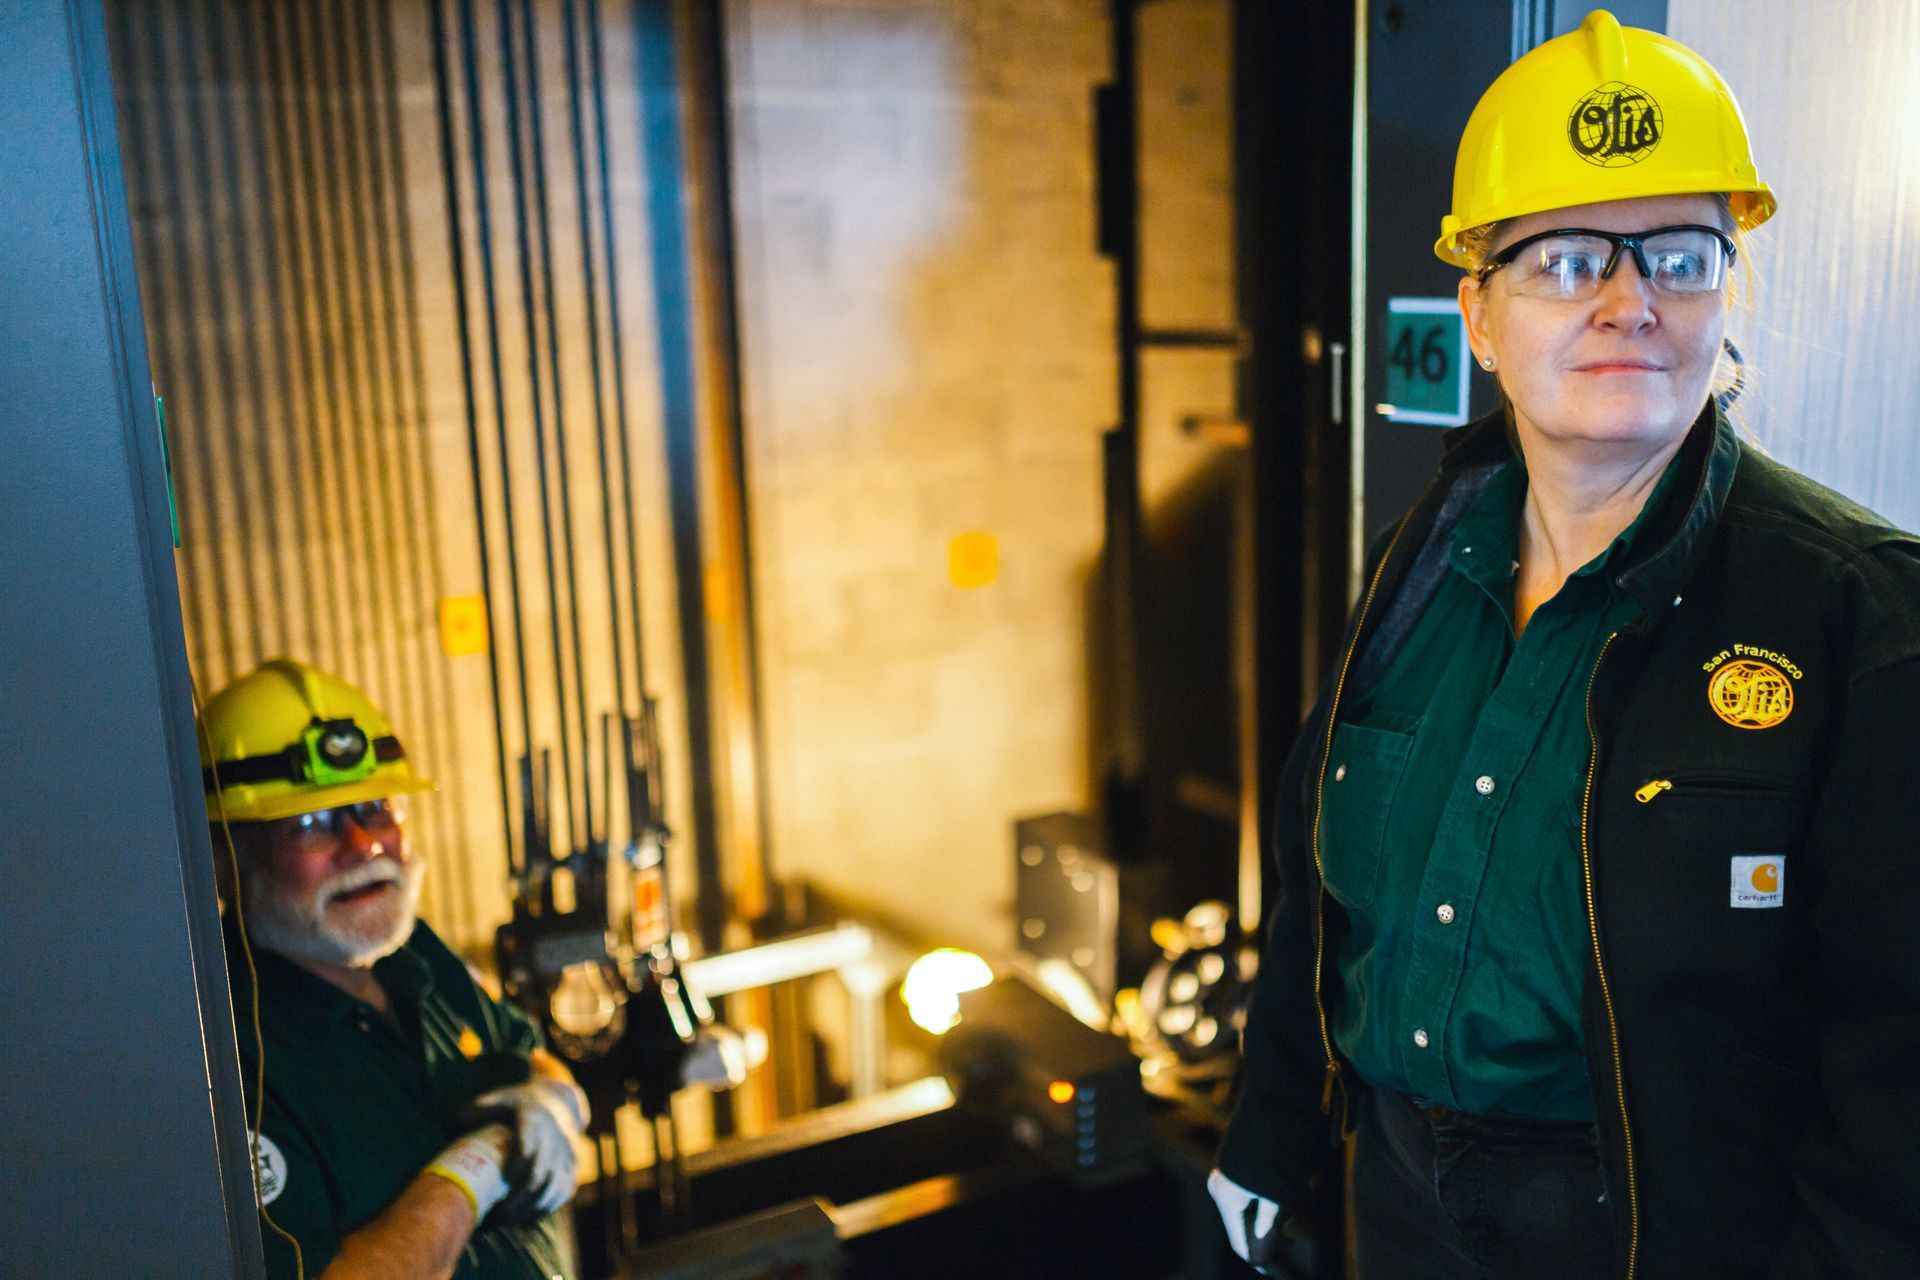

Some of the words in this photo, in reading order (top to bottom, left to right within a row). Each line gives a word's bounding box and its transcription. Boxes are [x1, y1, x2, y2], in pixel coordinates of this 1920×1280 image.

[1570, 93, 1659, 157] Otis
[1392, 326, 1448, 384] 46
[1703, 650, 1731, 672] San
[1734, 644, 1803, 680] Francisco
[1738, 894, 1777, 902] carhartt
